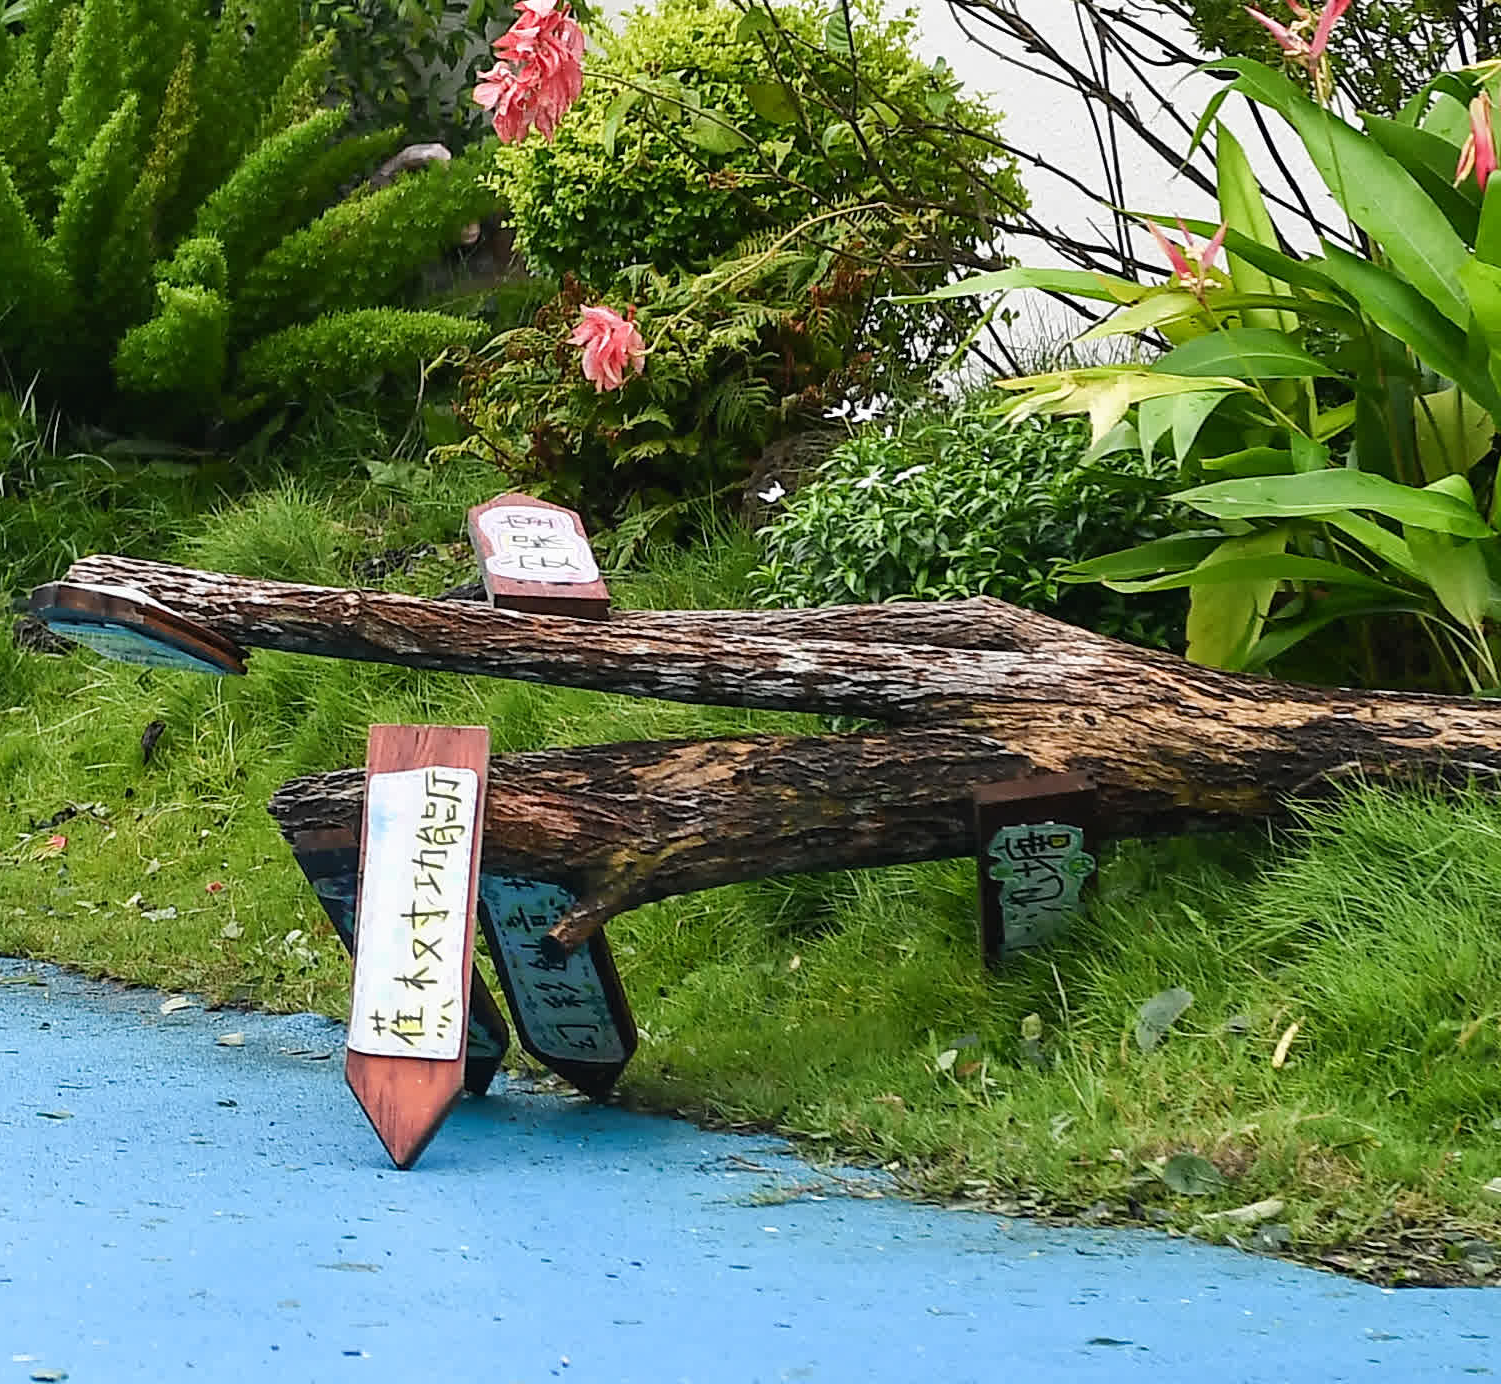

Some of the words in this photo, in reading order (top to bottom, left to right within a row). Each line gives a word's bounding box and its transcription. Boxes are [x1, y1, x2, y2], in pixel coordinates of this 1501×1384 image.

[500, 514, 581, 571] 安保室
[368, 770, 466, 1045] 蕉树功能厅
